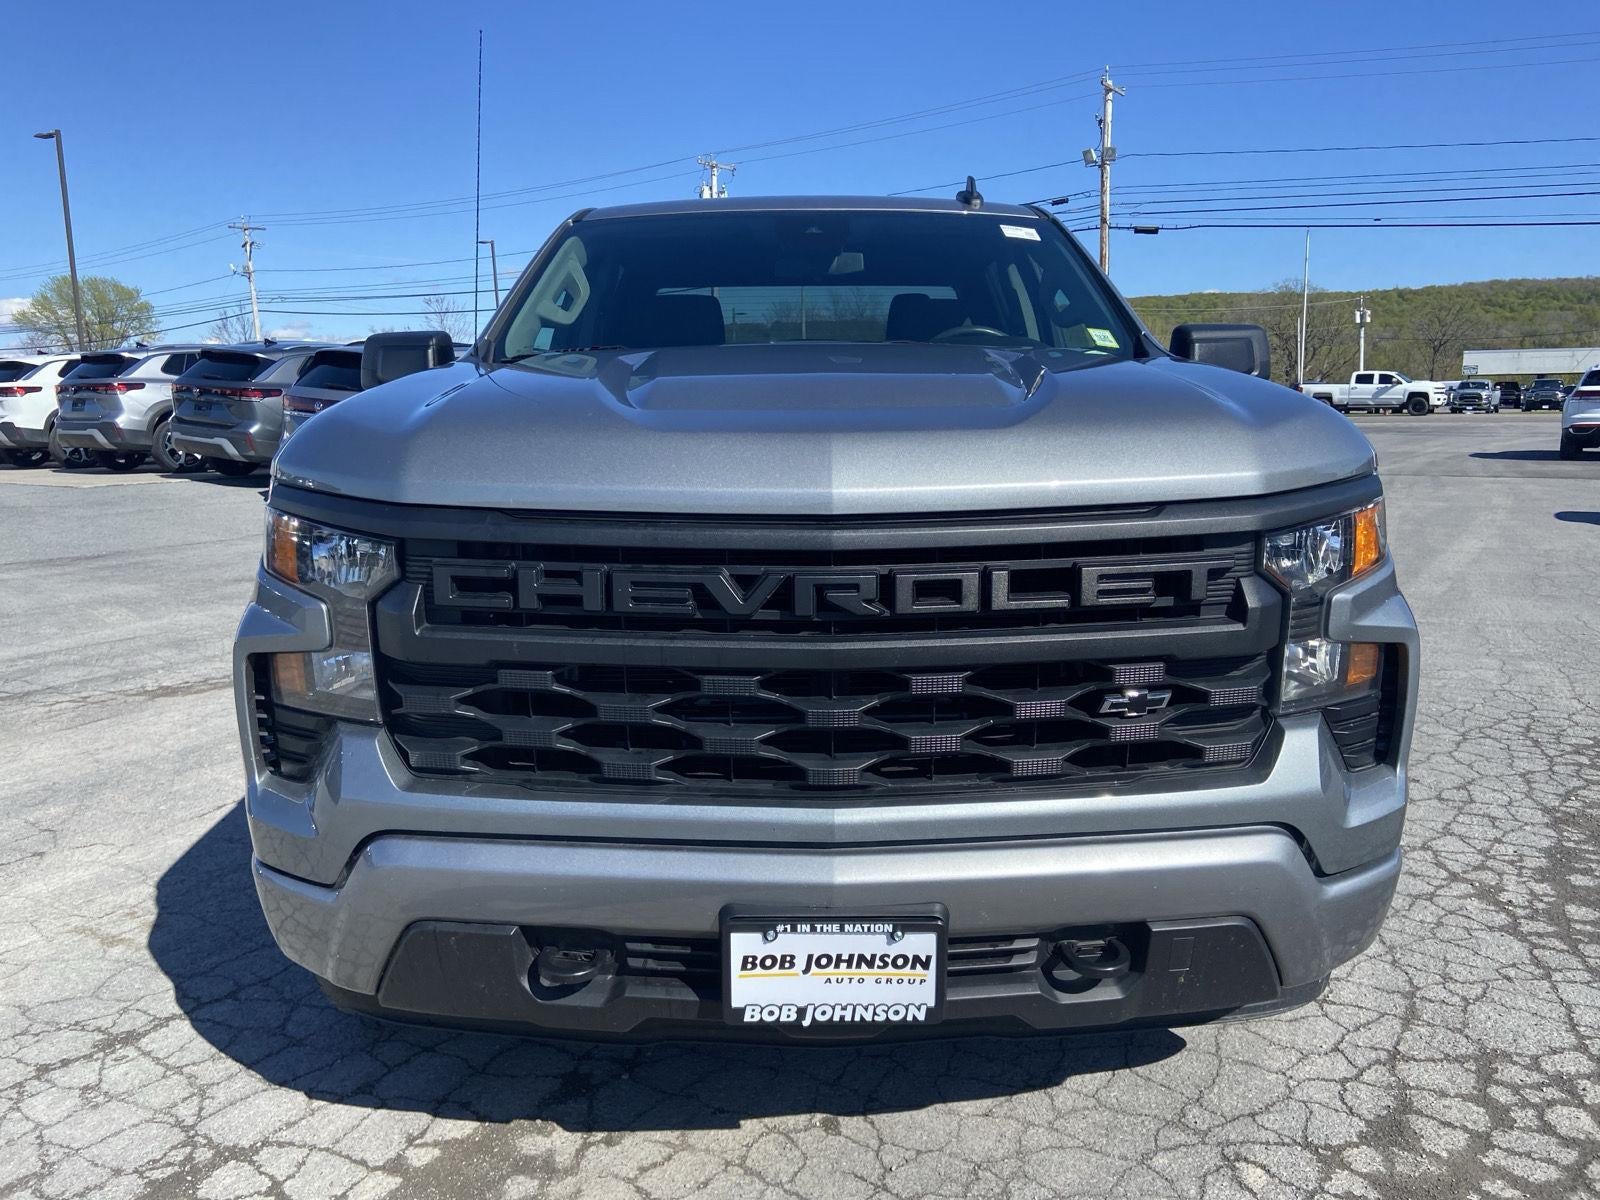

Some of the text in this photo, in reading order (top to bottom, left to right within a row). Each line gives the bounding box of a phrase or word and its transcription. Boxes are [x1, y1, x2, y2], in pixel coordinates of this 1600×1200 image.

[432, 559, 1236, 616] CHEVROLET
[776, 924, 893, 933] #1 IN THE NATION
[740, 954, 932, 975] BOB JOHNSON
[824, 977, 927, 985] AUTO GROUP
[743, 1004, 927, 1027] BOB JOHNSON
